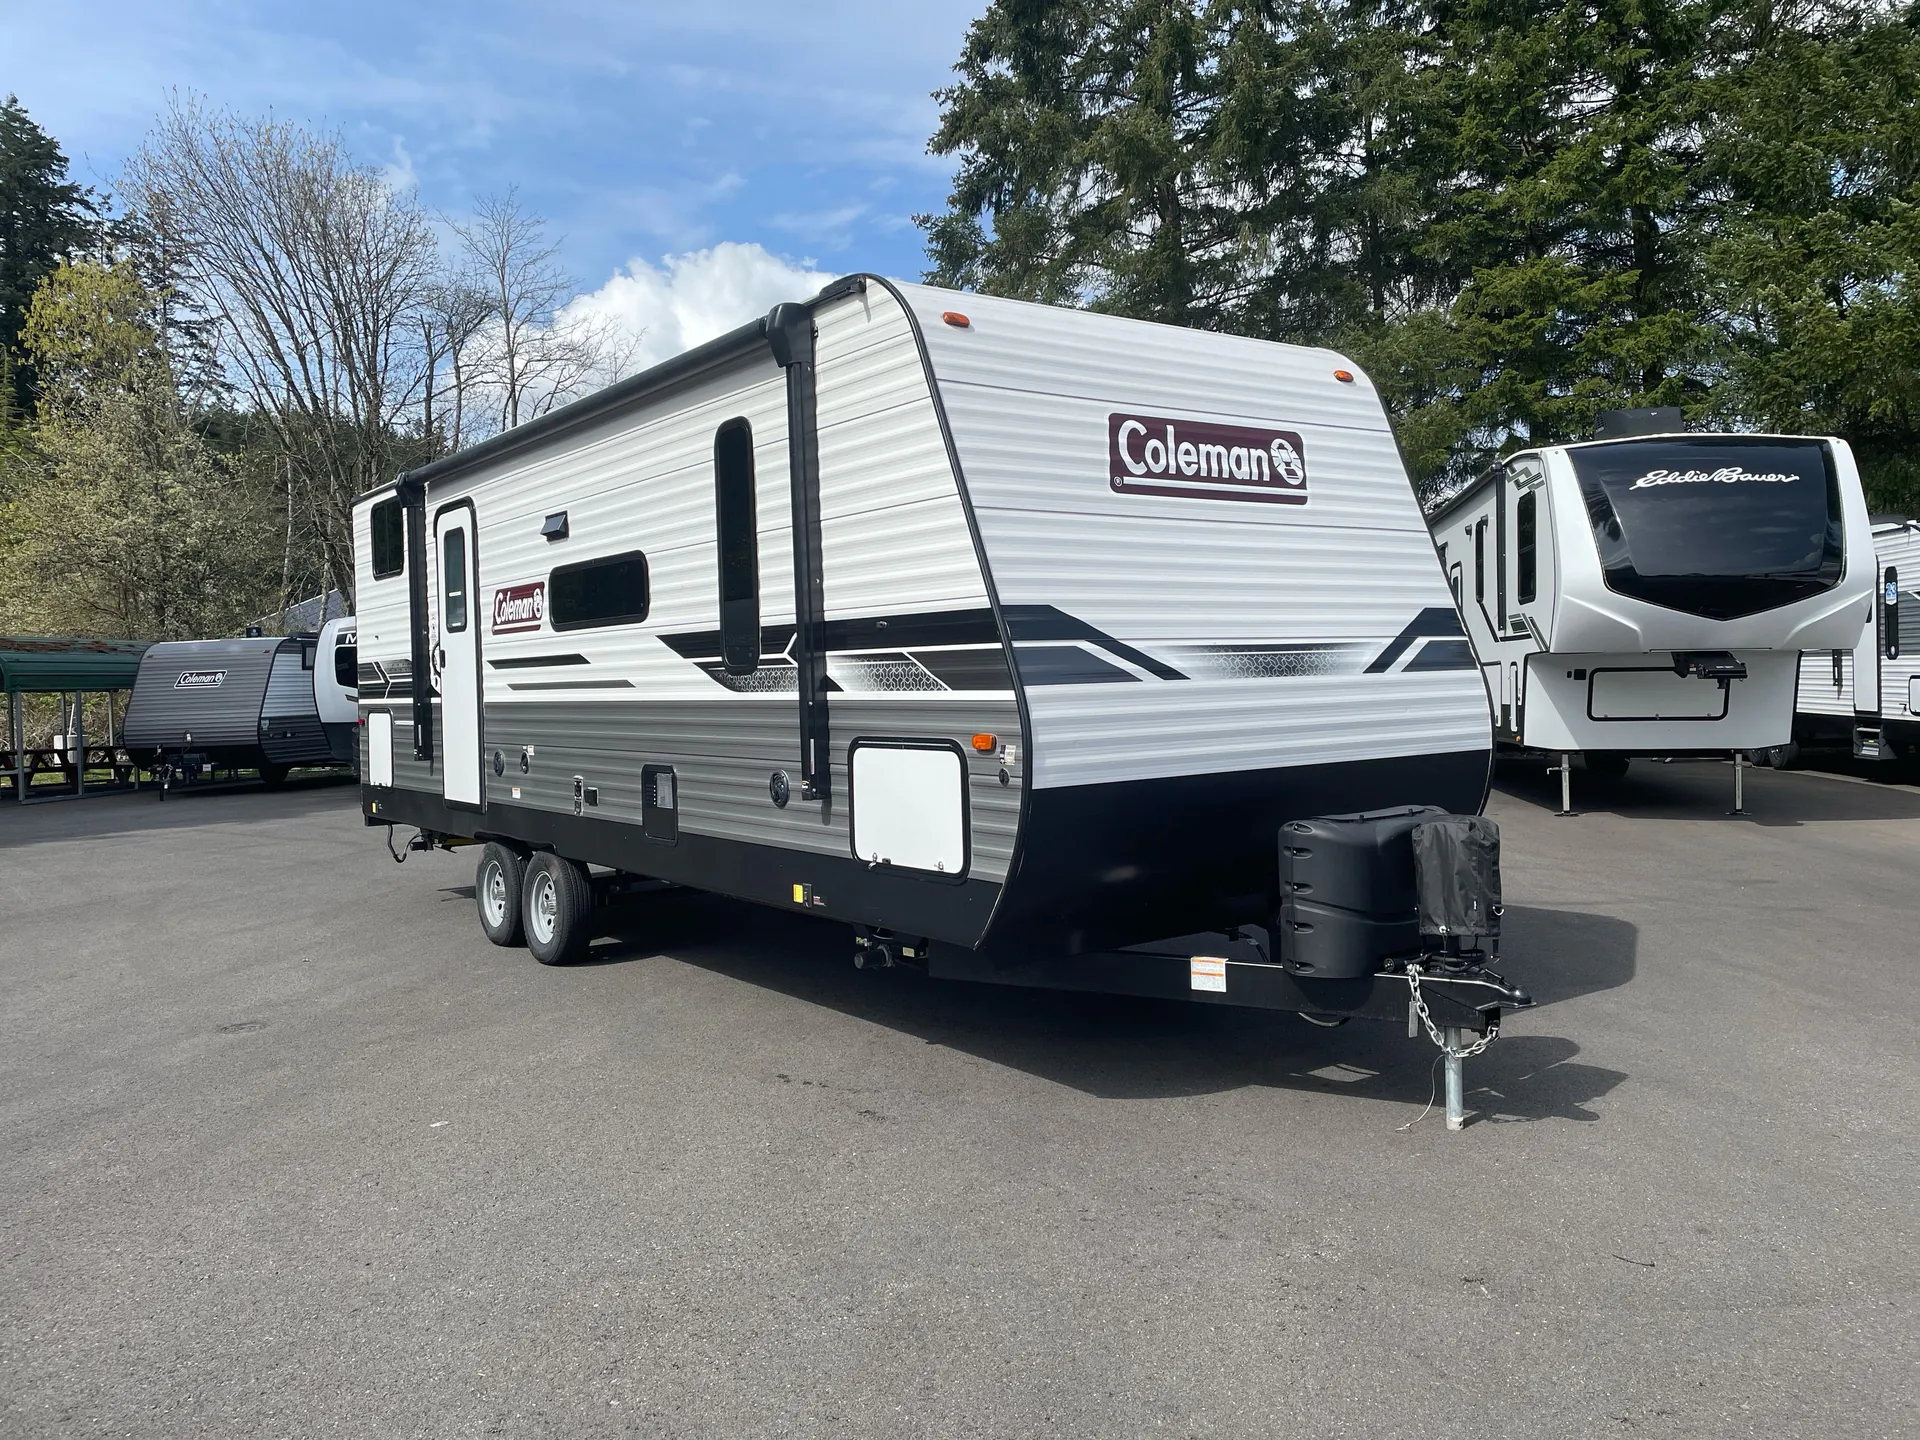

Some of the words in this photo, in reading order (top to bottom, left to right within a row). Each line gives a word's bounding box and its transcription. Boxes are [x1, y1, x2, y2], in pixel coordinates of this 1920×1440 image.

[1117, 419, 1271, 482] Coleman
[1628, 469, 1710, 490] Eddie
[1713, 467, 1801, 483] Bauer
[495, 591, 533, 625] Coleman
[180, 672, 215, 684] Coleman
